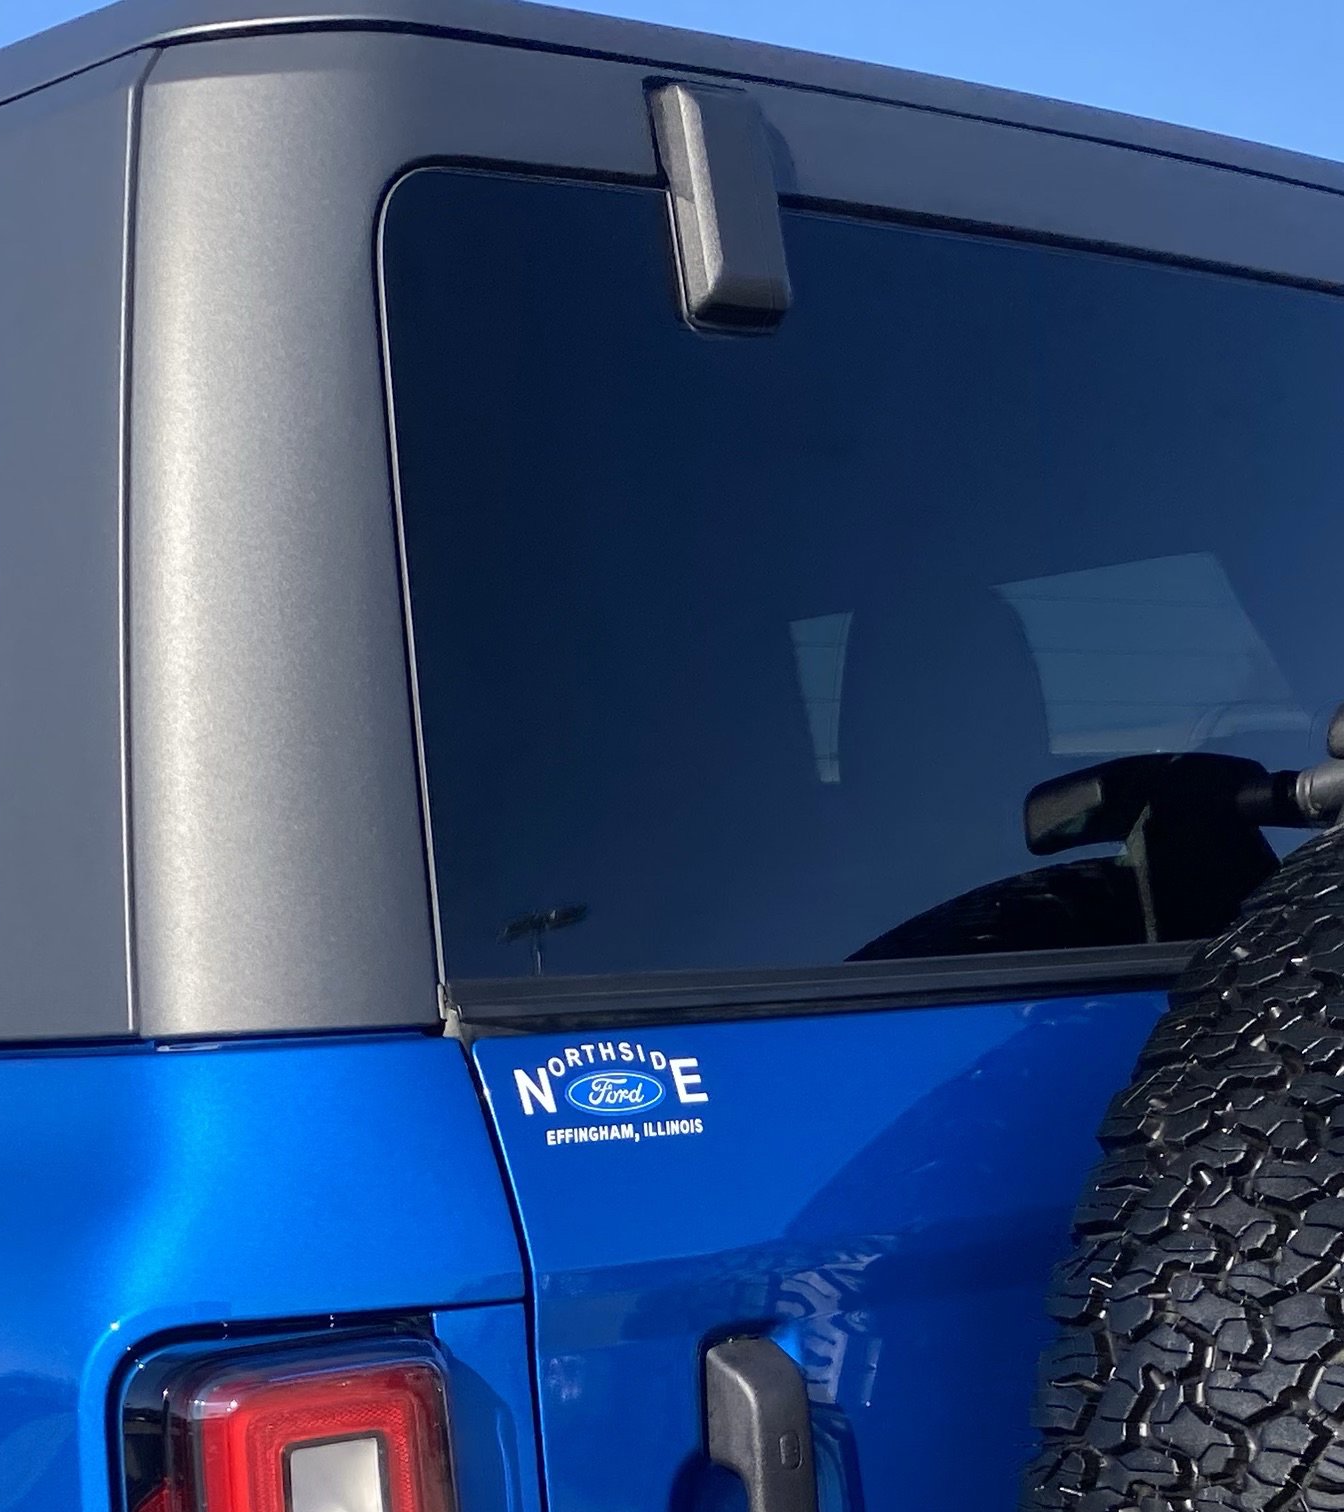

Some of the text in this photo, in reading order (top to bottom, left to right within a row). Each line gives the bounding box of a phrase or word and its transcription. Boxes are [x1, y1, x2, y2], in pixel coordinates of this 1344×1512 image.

[513, 1041, 709, 1115] NORTHSIDE
[588, 1077, 644, 1105] Ford
[546, 1118, 704, 1146] EFFINGHAM, ILLINOIS
